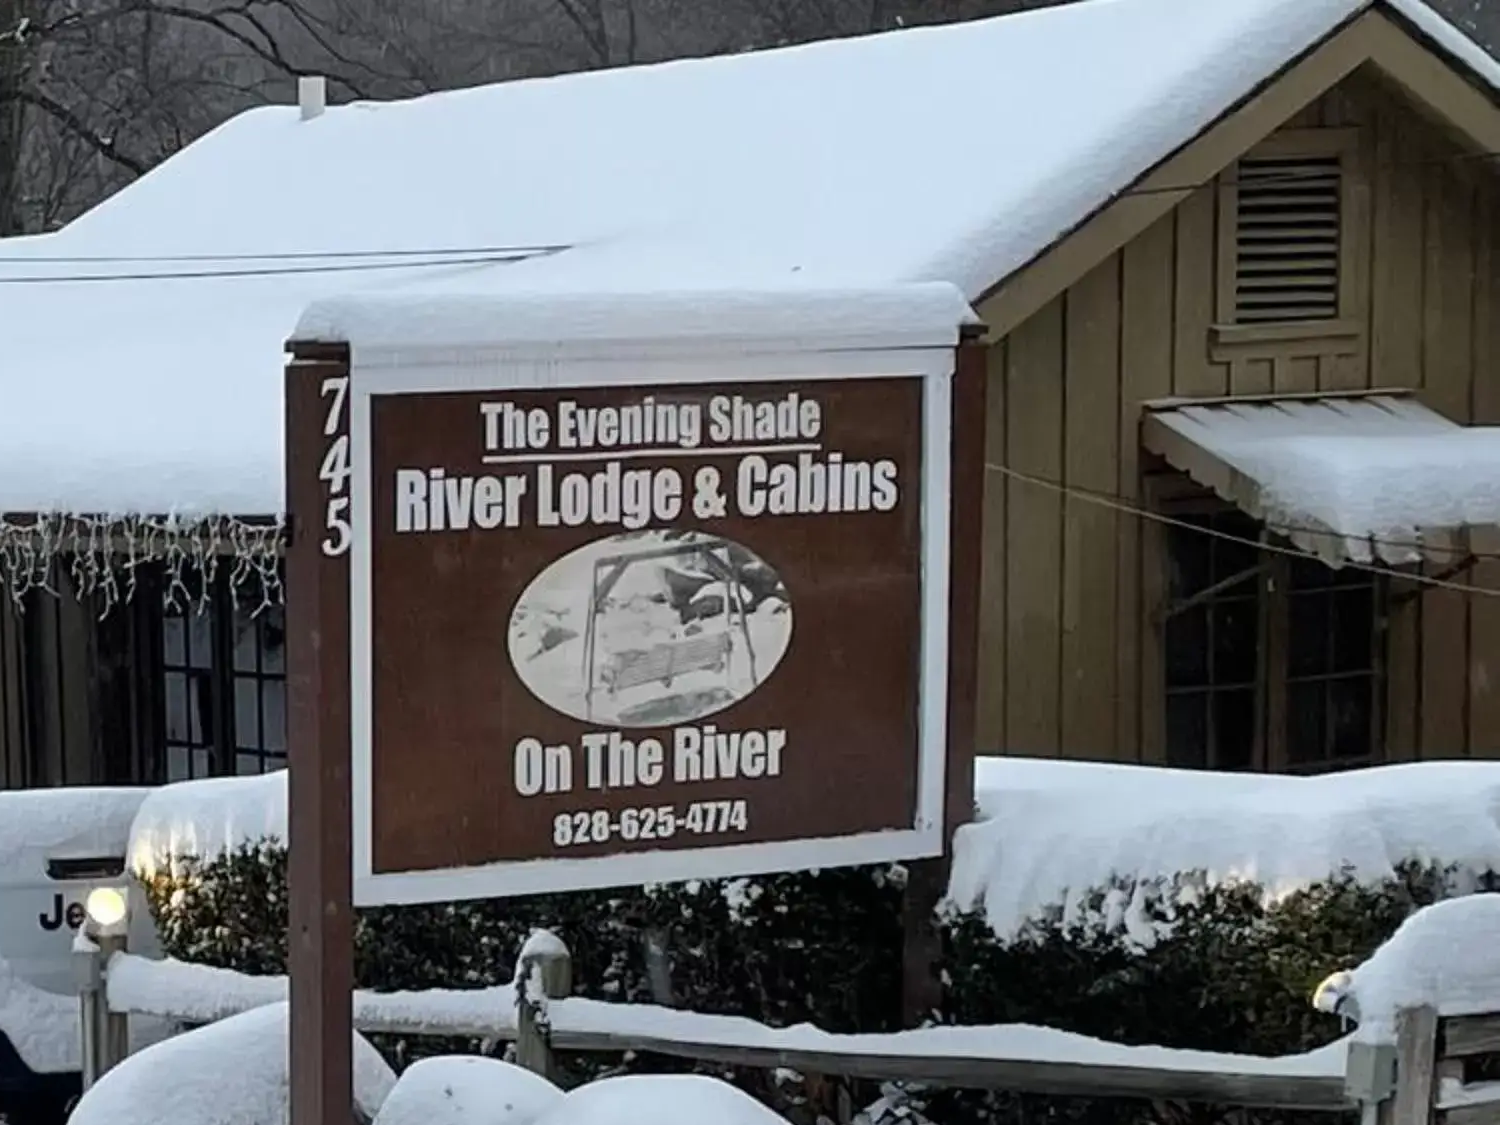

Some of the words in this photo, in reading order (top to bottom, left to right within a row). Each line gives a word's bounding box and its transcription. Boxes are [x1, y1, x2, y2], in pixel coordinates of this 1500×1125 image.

[480, 402, 550, 450] The
[558, 396, 702, 448] Evening
[708, 392, 822, 442] Shade
[319, 376, 352, 556] 745
[395, 468, 528, 532] River
[536, 462, 683, 529] Lodge
[691, 466, 728, 519] &
[736, 452, 898, 516] Cabins
[514, 738, 573, 795] On
[580, 732, 664, 789] The
[673, 725, 787, 782] River
[553, 800, 748, 846] 828-625-4774
[39, 893, 87, 931] Je
